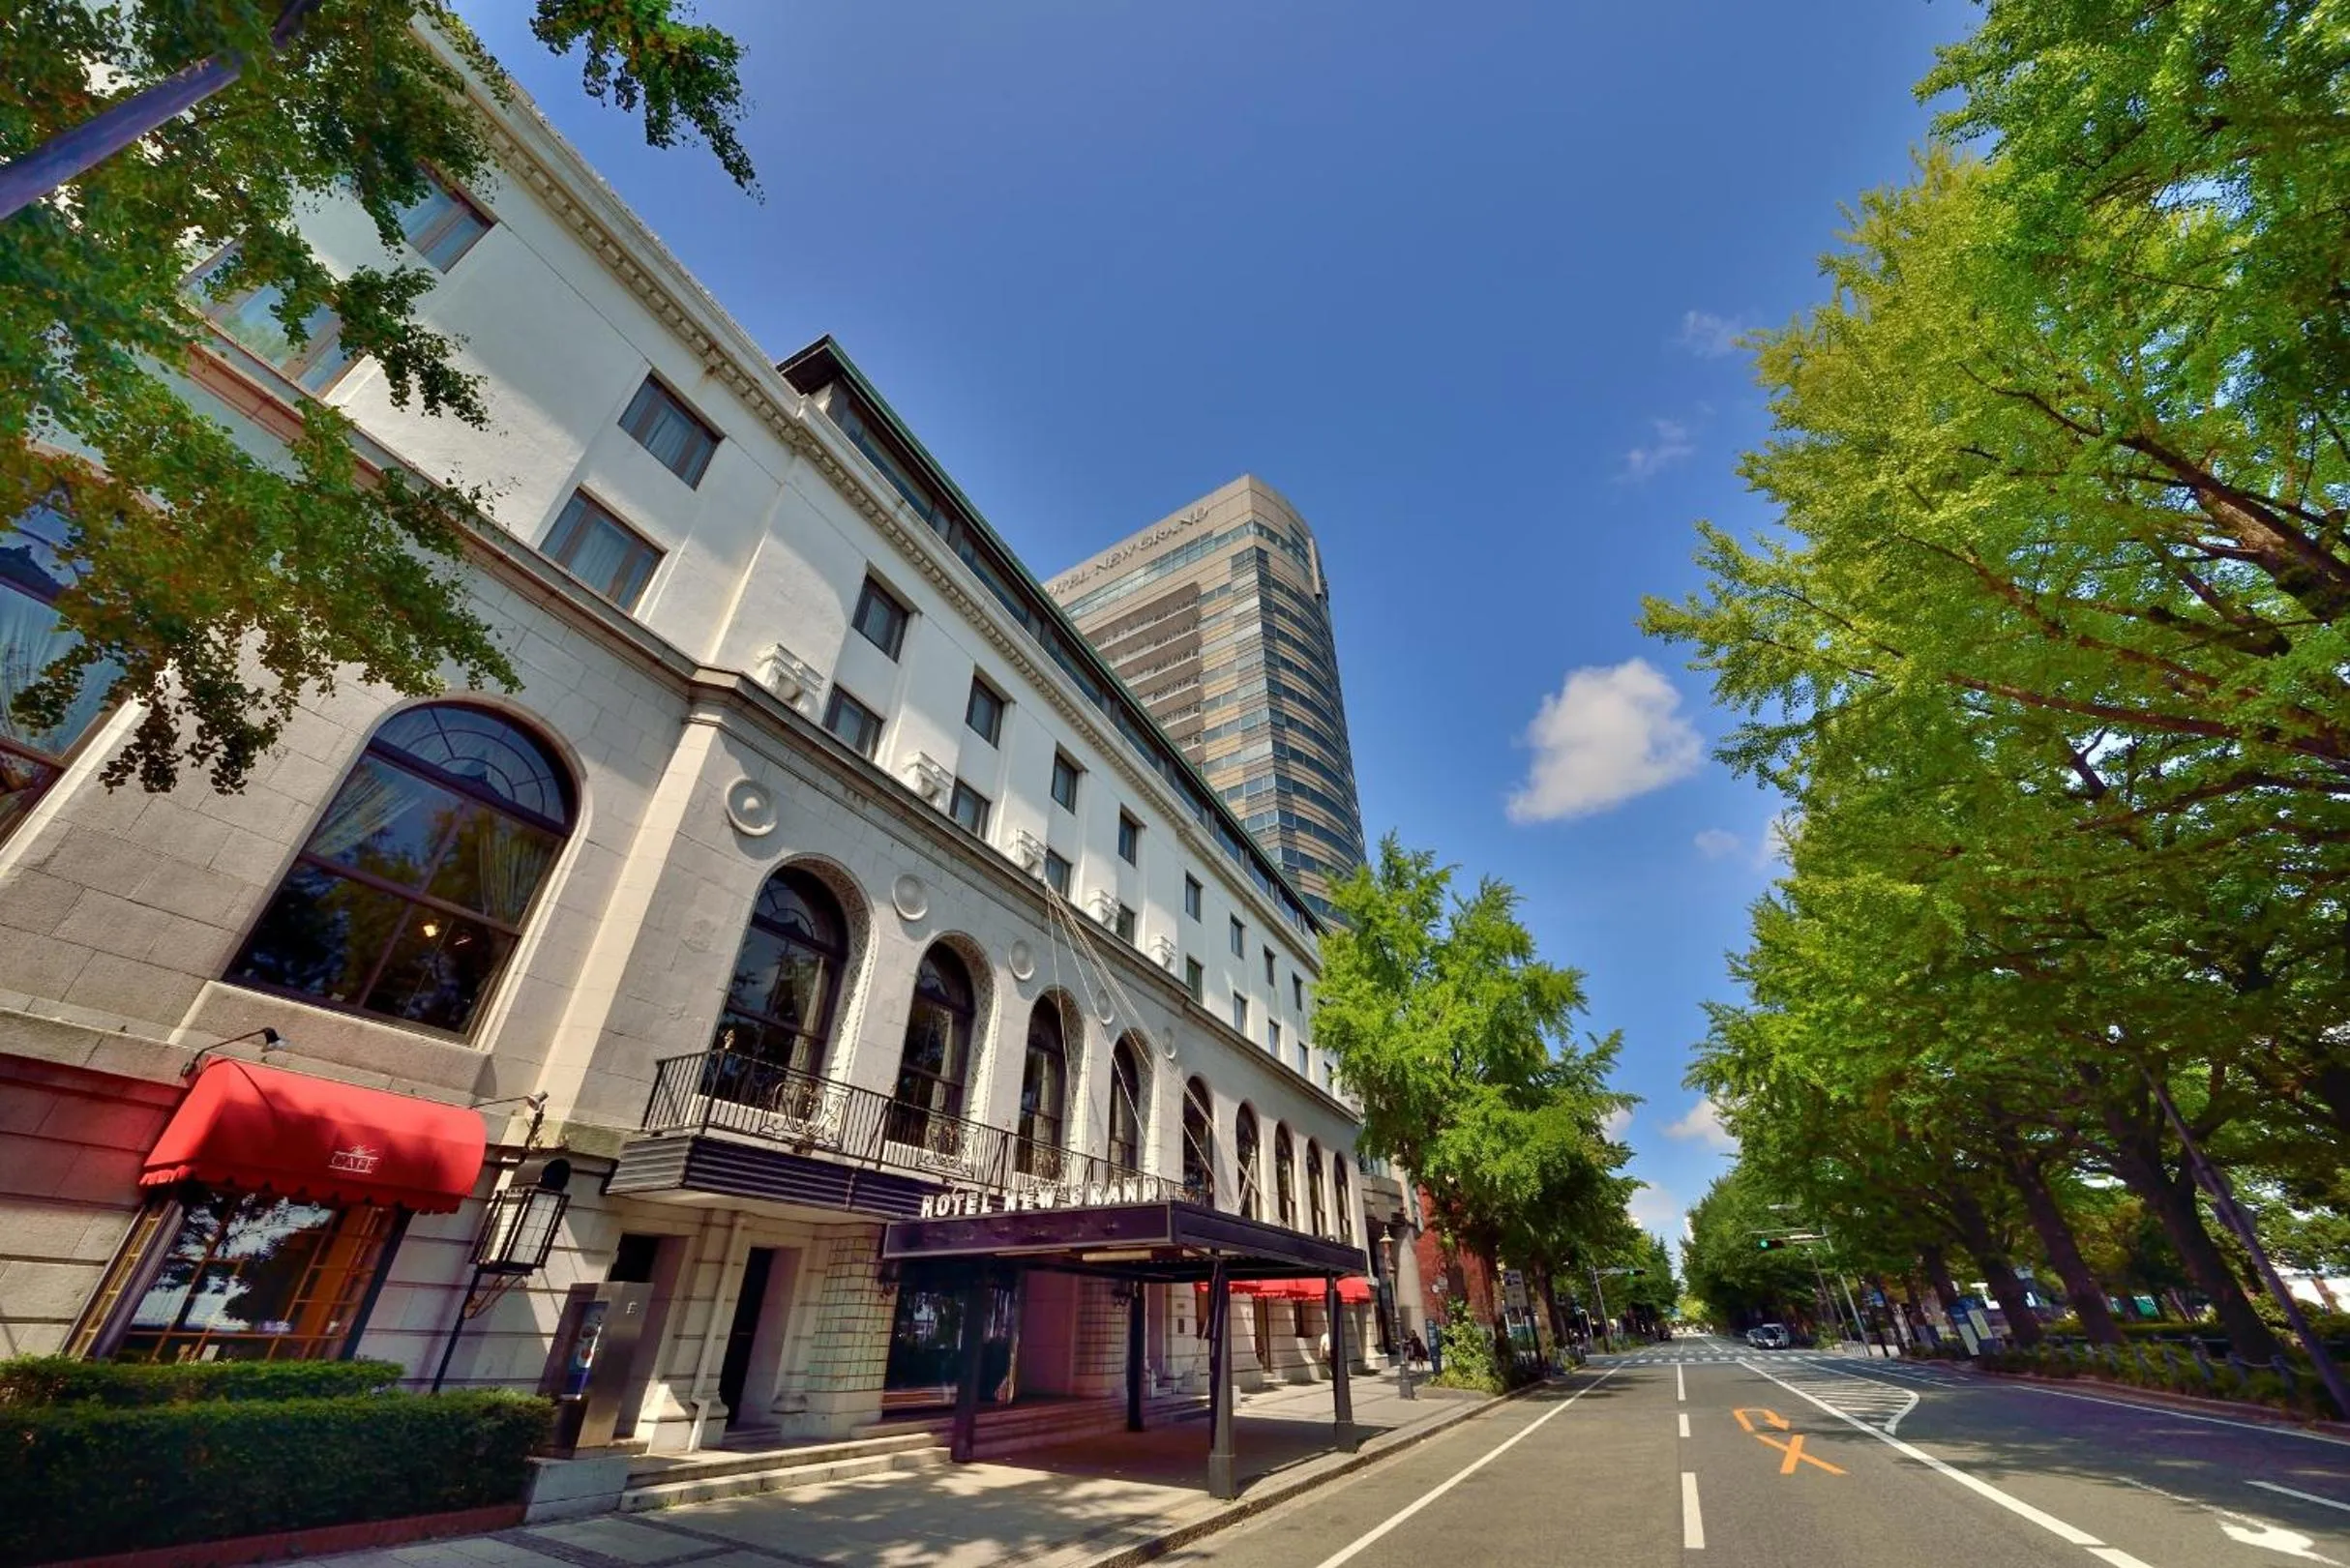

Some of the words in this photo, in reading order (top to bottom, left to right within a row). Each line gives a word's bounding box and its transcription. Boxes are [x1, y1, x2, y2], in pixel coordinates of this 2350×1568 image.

[1047, 569, 1090, 597] OTEL
[1095, 543, 1136, 576] NEW
[1139, 507, 1209, 550] GRAND
[920, 1191, 993, 1219] HOTEL
[1003, 1185, 1057, 1212] NEW
[1069, 1174, 1159, 1207] GRAND
